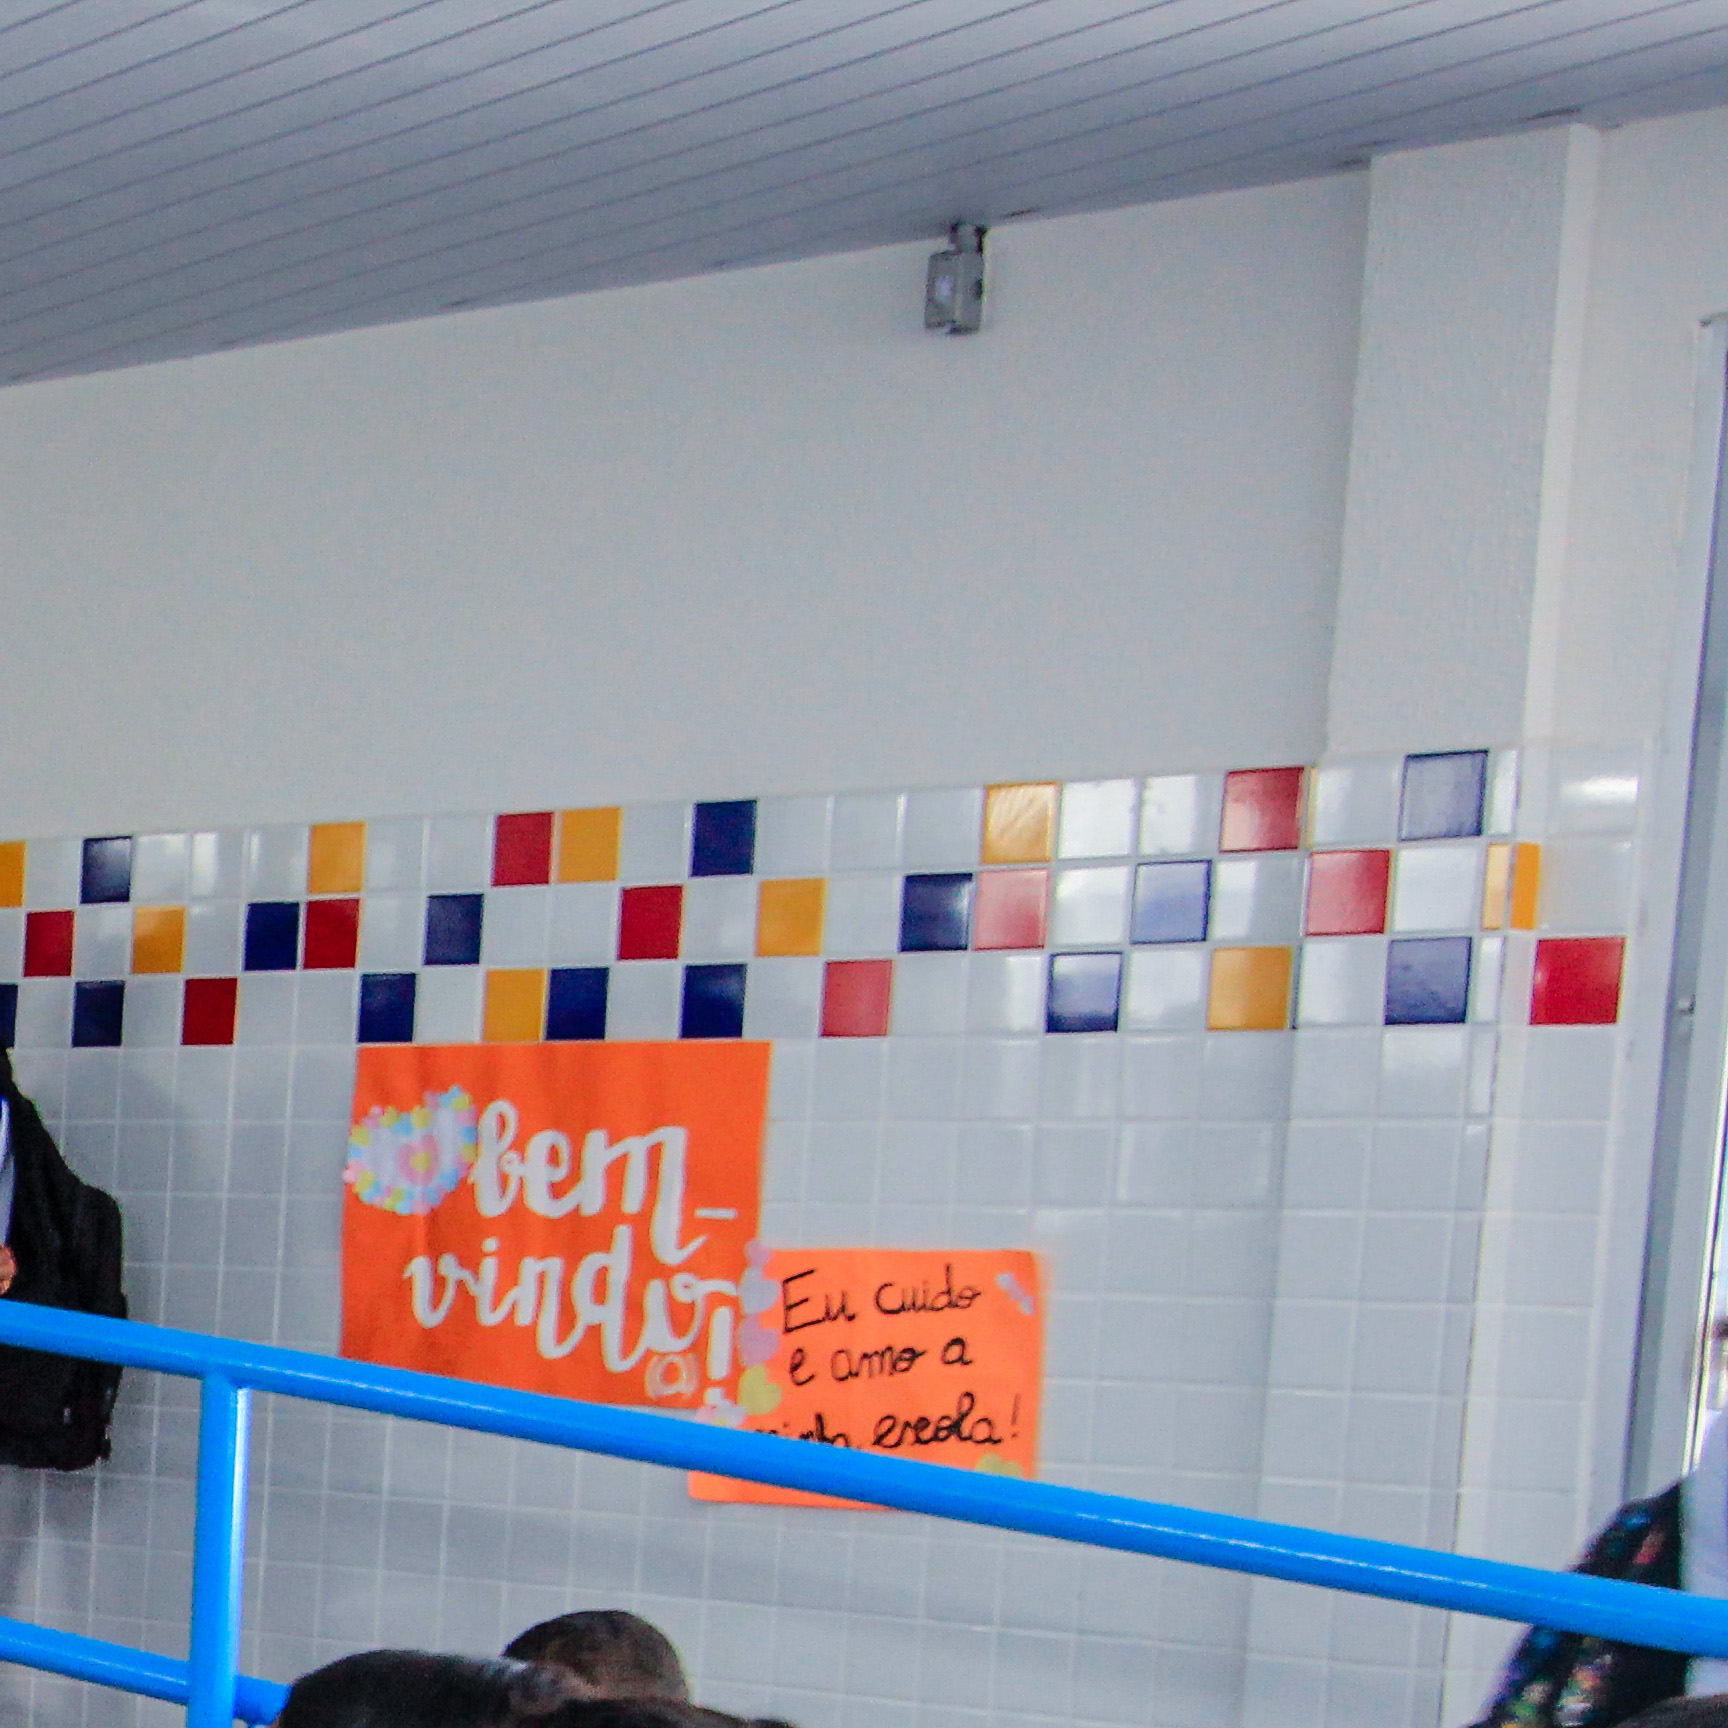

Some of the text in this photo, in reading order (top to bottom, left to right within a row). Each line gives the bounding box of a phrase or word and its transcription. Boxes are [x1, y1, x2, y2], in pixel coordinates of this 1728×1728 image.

[782, 1270, 856, 1334] Eu
[789, 1337, 973, 1386] e amo a
